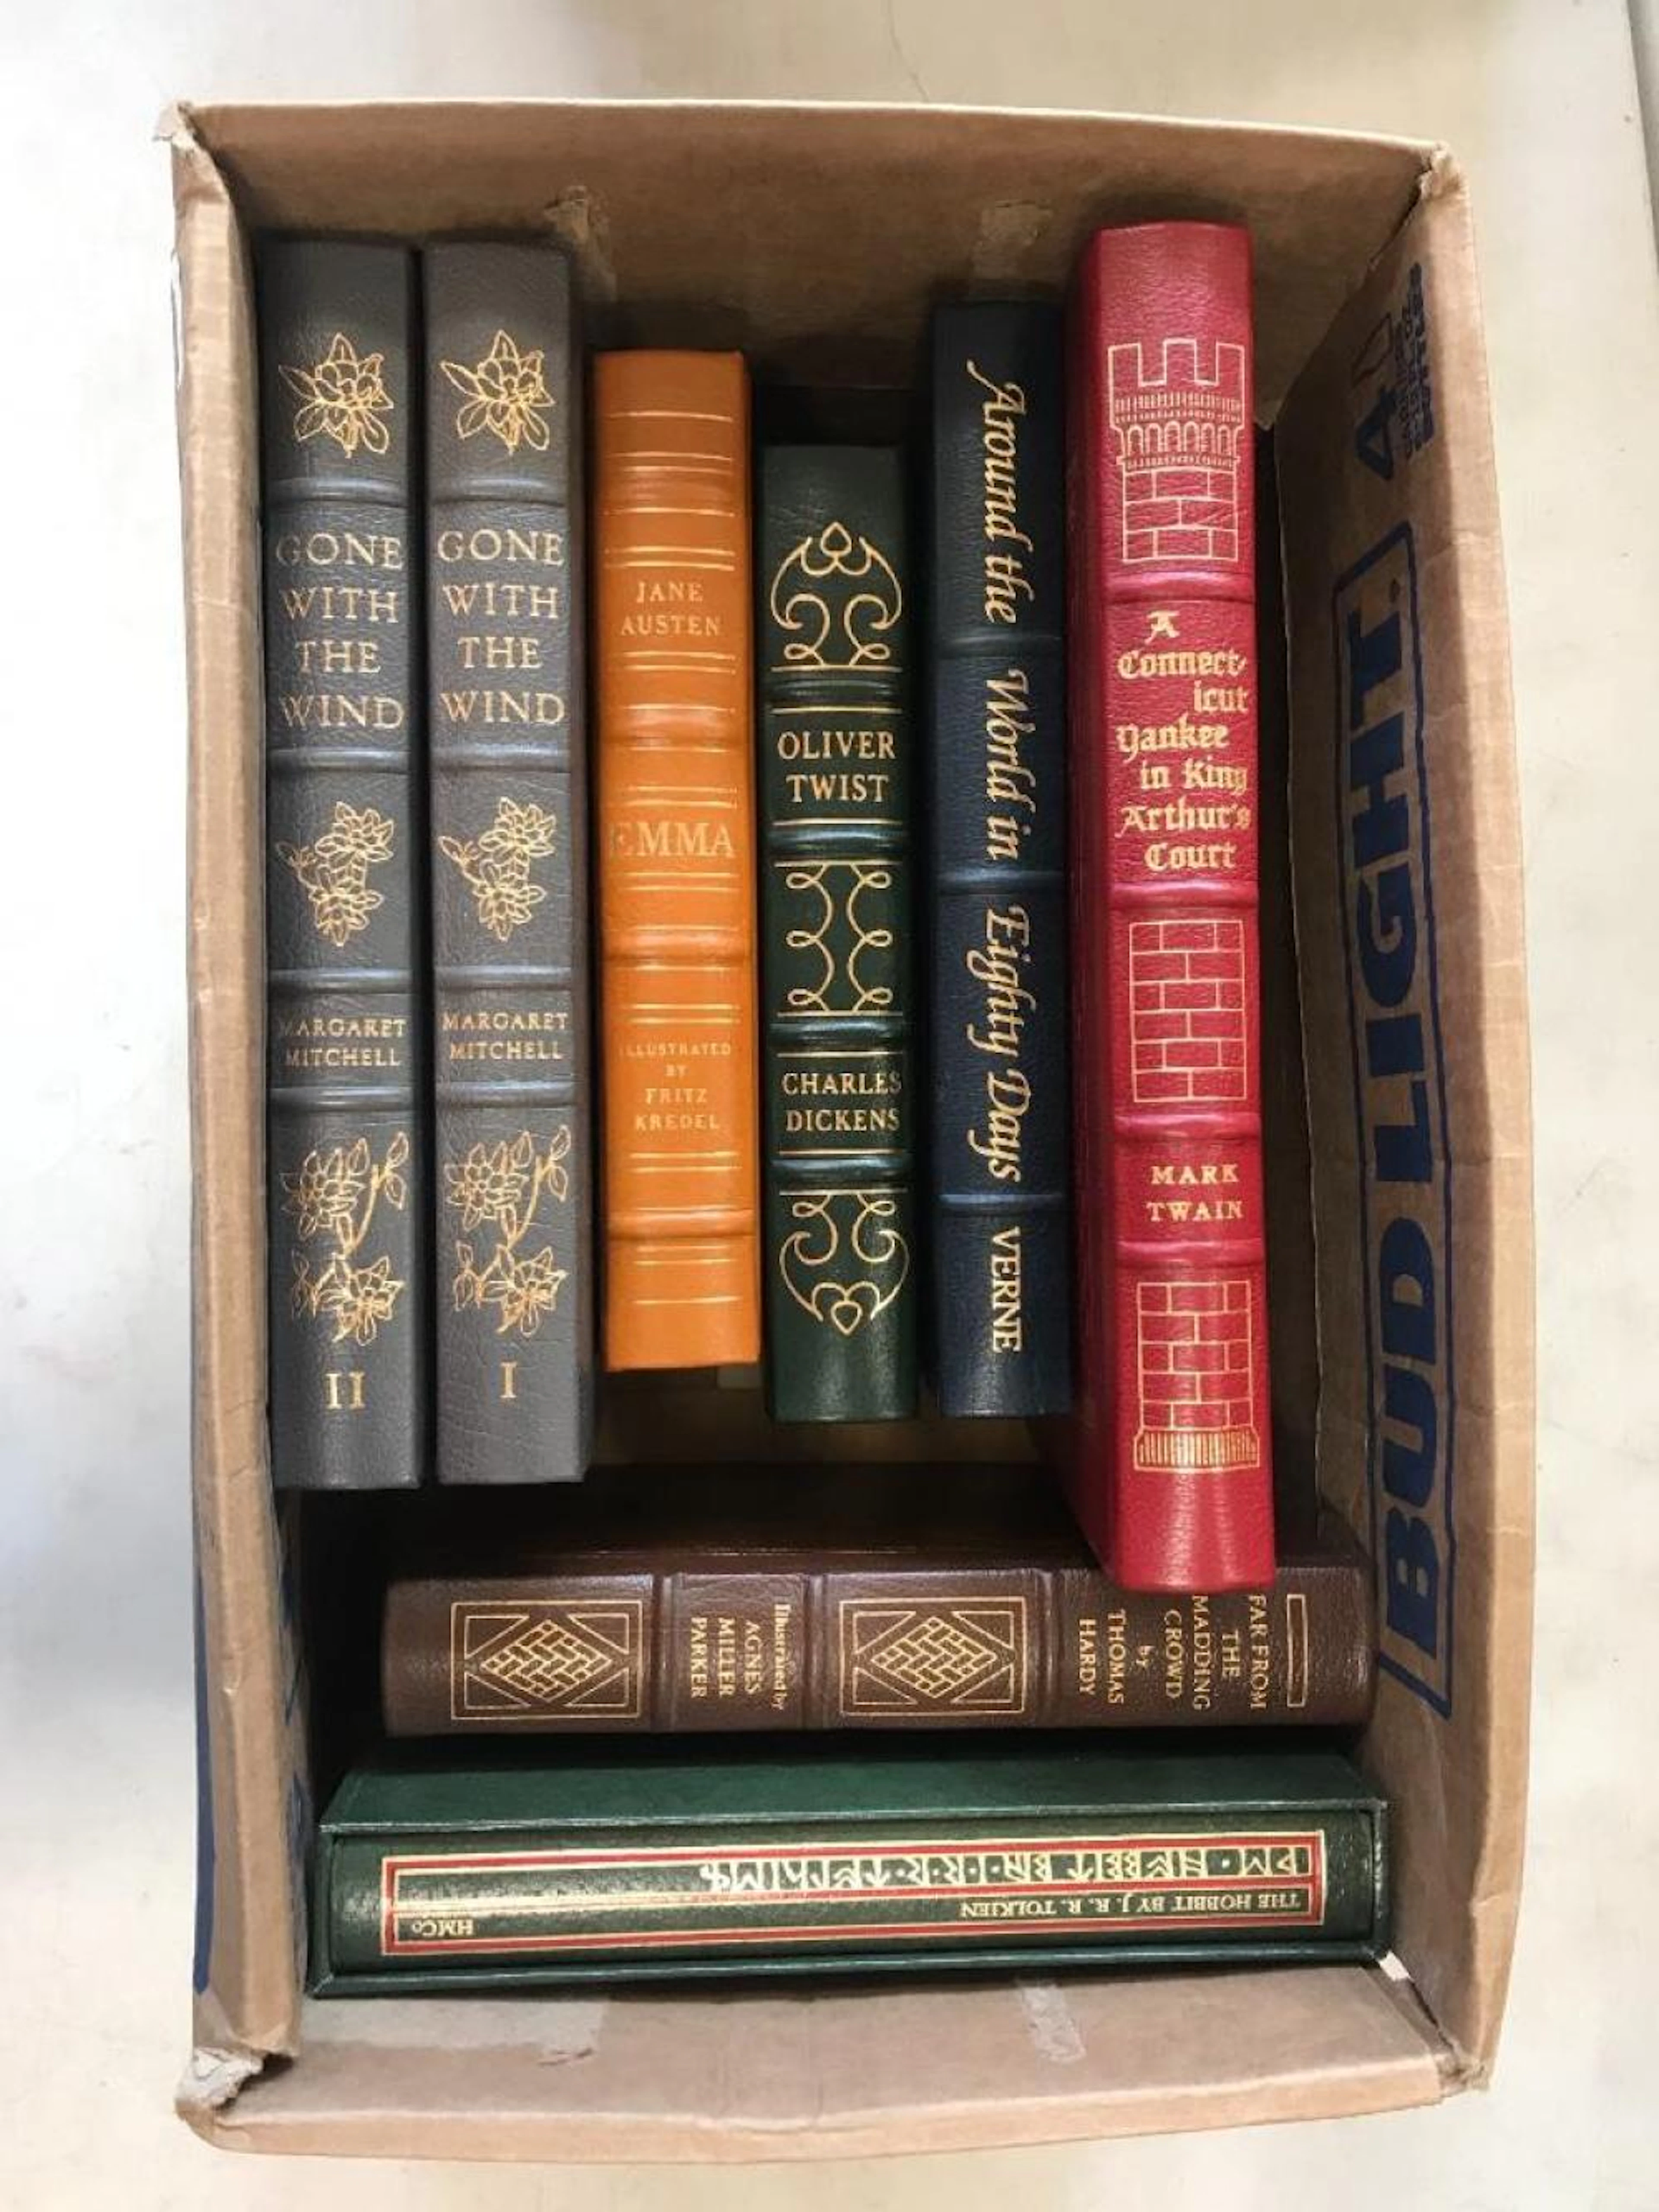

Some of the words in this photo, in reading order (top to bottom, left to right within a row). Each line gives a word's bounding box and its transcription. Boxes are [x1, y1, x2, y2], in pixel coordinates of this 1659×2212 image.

[966, 360, 1033, 553] Around
[276, 532, 404, 570] GONE
[437, 528, 565, 567] GONE
[282, 586, 399, 623] WITH
[442, 582, 559, 619] WITH
[636, 581, 704, 603] JANE
[985, 552, 1034, 625] the
[620, 615, 721, 637] AUSTEN
[1145, 609, 1180, 645] A
[295, 639, 381, 674] THE
[457, 636, 544, 669] THE
[278, 694, 405, 730] WIND
[439, 690, 565, 725] WIND
[1193, 680, 1249, 713] icut
[777, 730, 896, 760] OLIVER
[985, 668, 1036, 813] World
[1115, 712, 1230, 764] Yankee
[785, 773, 890, 803] TWIST
[1140, 759, 1170, 790] in
[1182, 755, 1248, 796] King
[1114, 795, 1252, 838] Arthur's
[609, 821, 735, 859] EMMA
[985, 814, 1032, 862] in
[1144, 841, 1237, 872] Court
[966, 904, 1037, 1059] Eighty
[277, 1017, 407, 1038] MARGARET
[442, 1011, 569, 1031] MARGARET
[285, 1047, 401, 1067] MITCHELL
[450, 1041, 564, 1060] MITCHELL
[619, 1042, 731, 1057] ILLUSTRATED
[664, 1064, 687, 1078] BY
[781, 1072, 903, 1095] CHARLES
[644, 1087, 708, 1104] FRITZ
[634, 1114, 720, 1131] KREDEL
[785, 1108, 901, 1132] DICKENS
[967, 1068, 1033, 1183] Days
[1150, 1163, 1240, 1185] MARK
[1145, 1200, 1244, 1222] TWAIN
[991, 1225, 1022, 1354] VERNE
[325, 1371, 365, 1410] II
[499, 1361, 517, 1399] I
[1377, 1216, 1440, 1661] BUD
[1249, 1595, 1268, 1639] FAR
[691, 1617, 709, 1699] PARKER
[718, 1617, 736, 1698] MILLER
[744, 1619, 762, 1696] AGNES
[1079, 1618, 1097, 1696] HARDY
[1107, 1608, 1128, 1705] THOMAS
[1164, 1609, 1184, 1699] CROWD
[1191, 1595, 1211, 1711] MADDING
[1222, 1629, 1241, 1680] THE
[1250, 1645, 1269, 1709] FROM
[959, 1900, 1057, 1919] TOLKIEN
[1060, 1899, 1083, 1915] R.
[1087, 1897, 1111, 1914] R.
[1116, 1893, 1132, 1913] J.
[1138, 1896, 1166, 1913] BY
[1172, 1894, 1252, 1912] HOBBIT
[1258, 1894, 1301, 1910] THE
